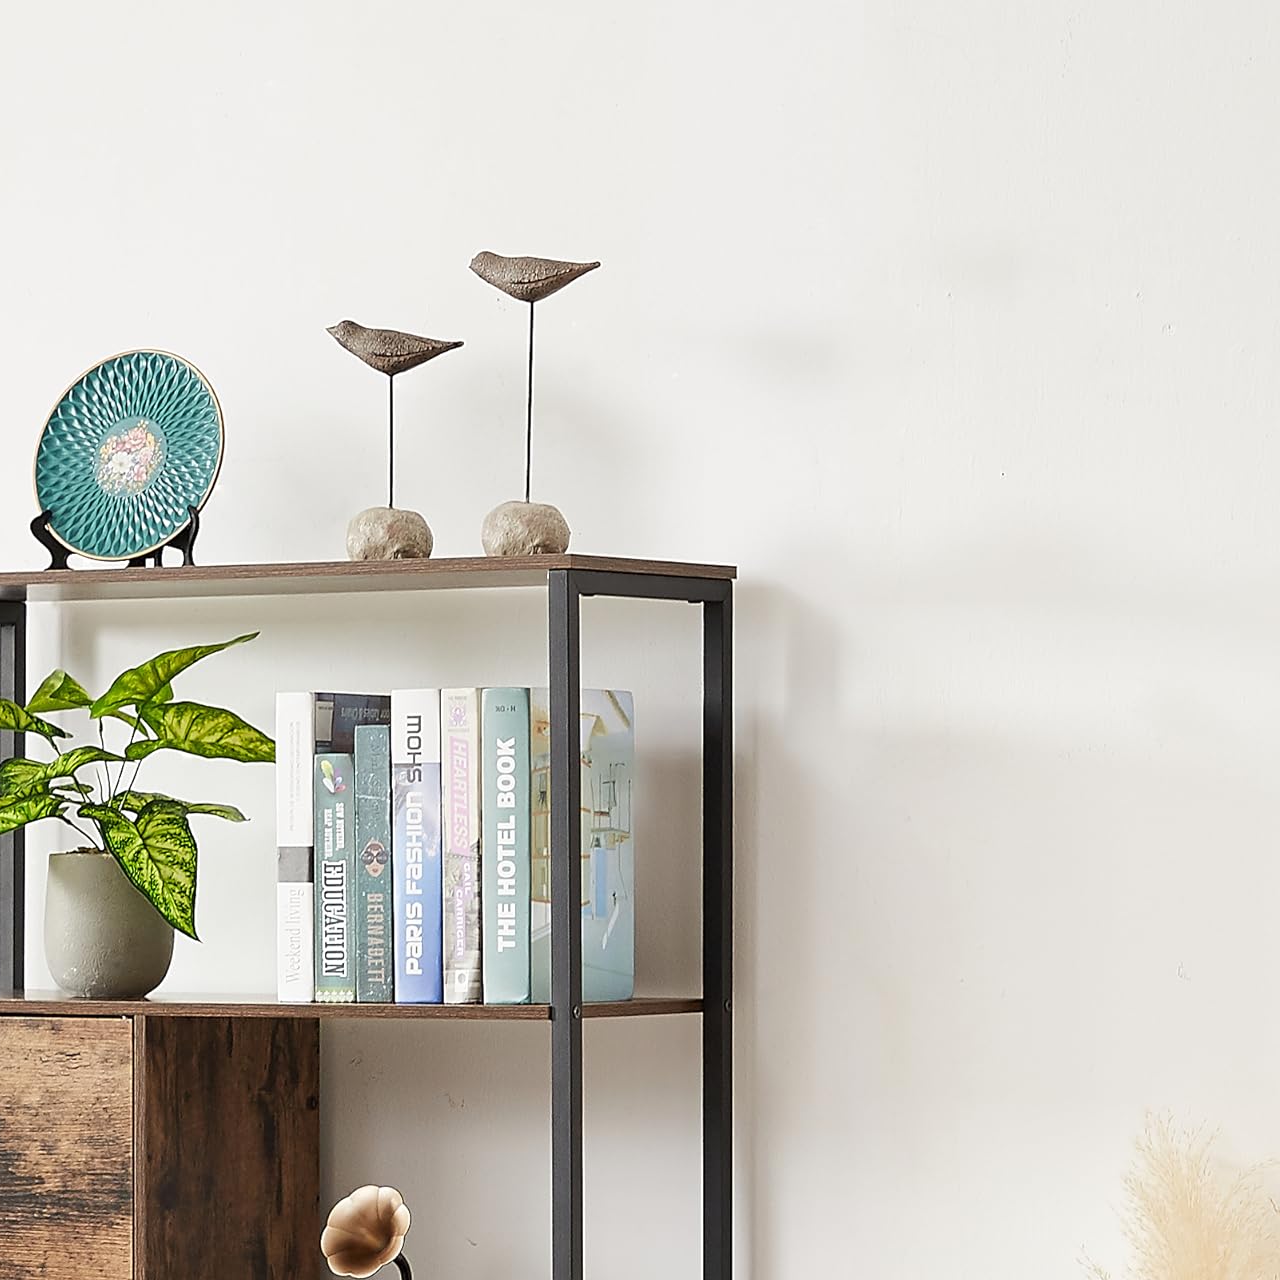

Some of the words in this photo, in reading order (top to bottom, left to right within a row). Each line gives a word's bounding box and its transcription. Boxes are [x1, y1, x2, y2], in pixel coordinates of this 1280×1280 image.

[405, 714, 423, 784] SHOW
[496, 736, 516, 809] BOOK
[450, 739, 469, 849] HEARTLESS
[496, 815, 516, 896] HOTEL
[285, 888, 304, 924] living
[323, 861, 345, 976] EDUCATION
[496, 902, 516, 953] THE
[285, 927, 303, 985] Weekend
